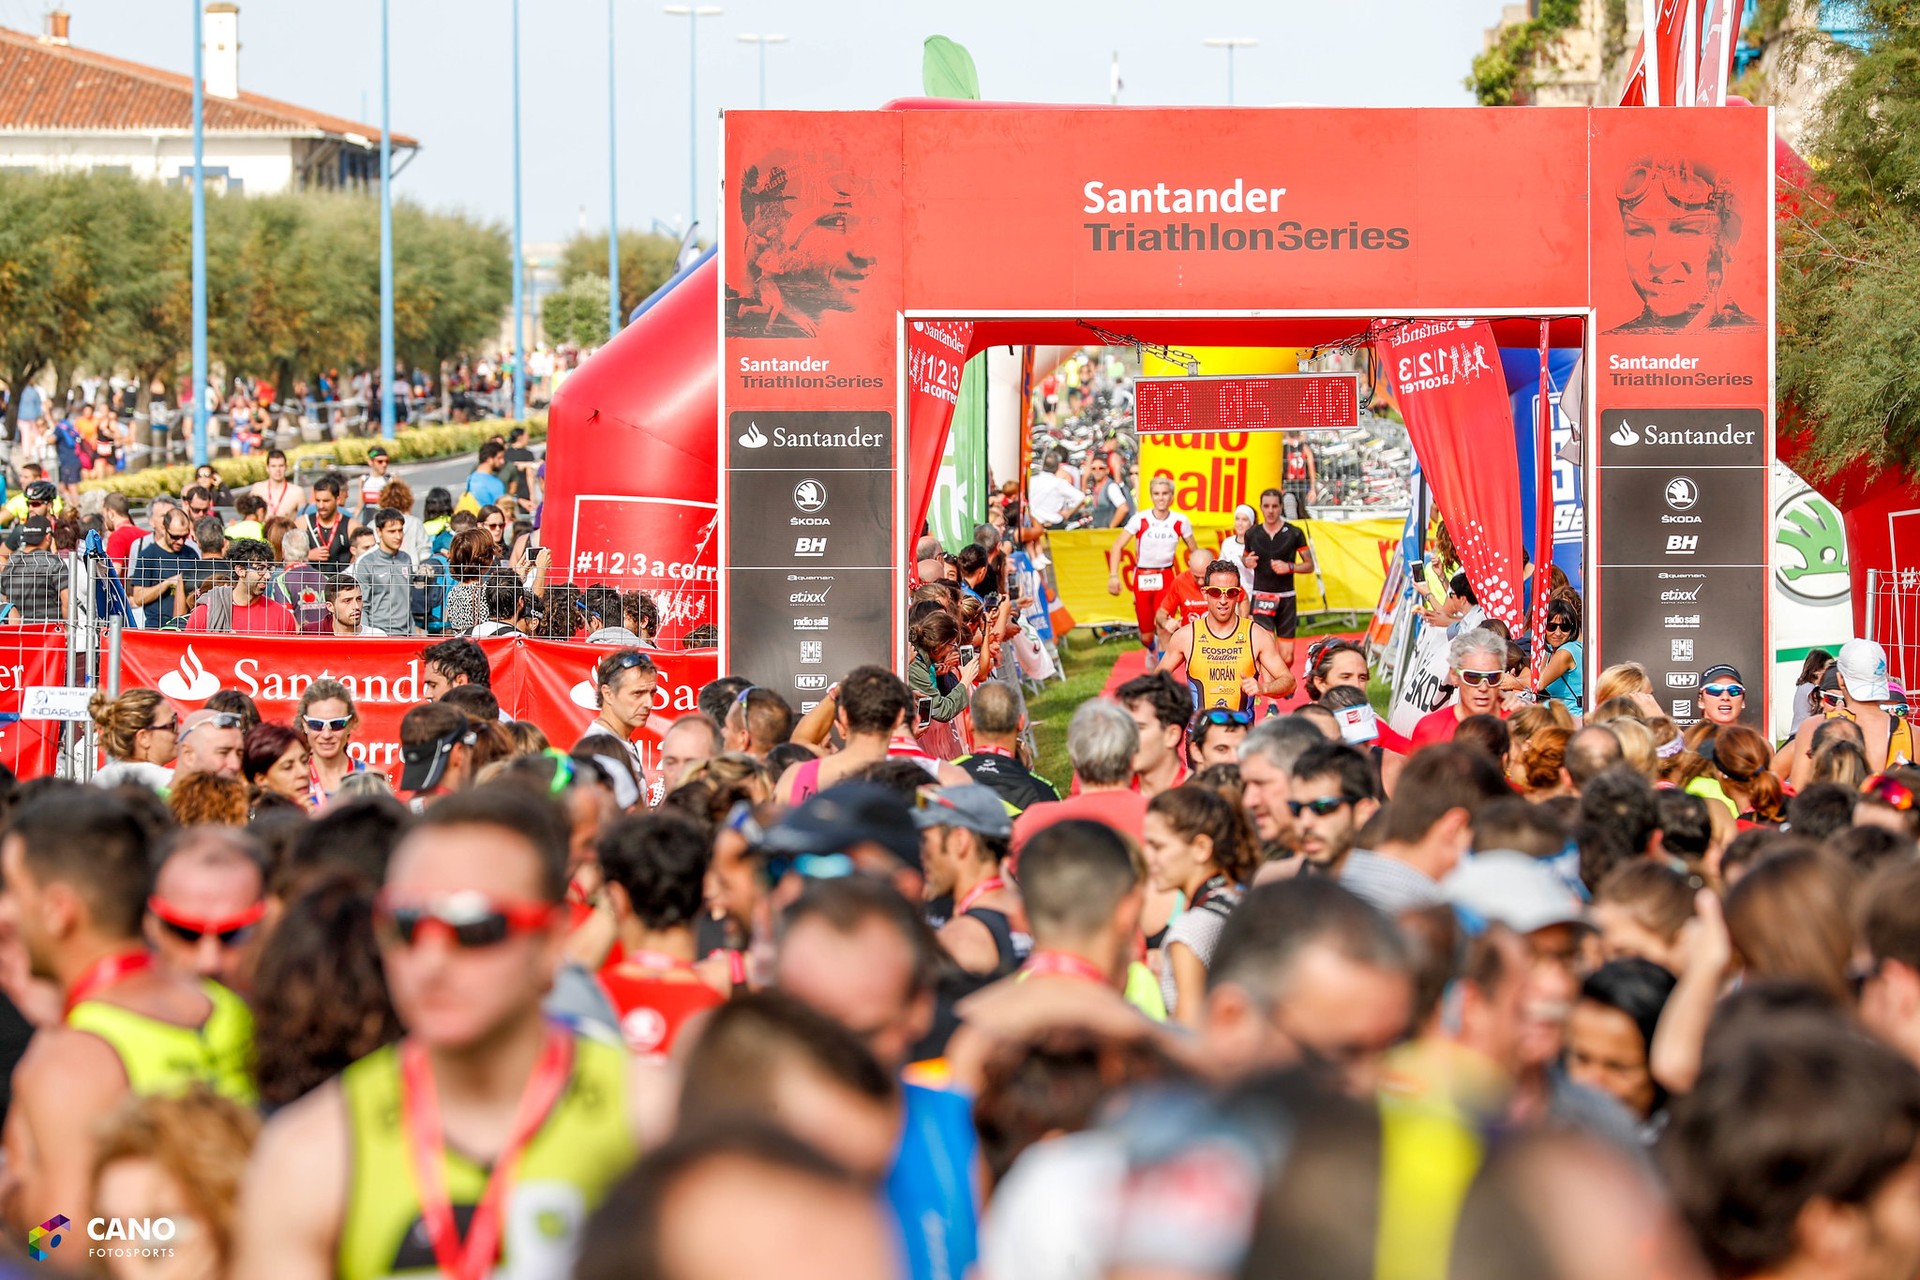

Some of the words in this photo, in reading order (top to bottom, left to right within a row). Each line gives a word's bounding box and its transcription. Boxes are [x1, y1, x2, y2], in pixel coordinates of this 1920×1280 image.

[1084, 179, 1286, 214] Santander
[923, 321, 965, 355] Santander
[740, 356, 830, 372] Santander
[1609, 354, 1699, 370] Santander
[1139, 383, 1190, 431] 03
[1219, 381, 1270, 428] 05
[1299, 379, 1350, 427] 40
[773, 426, 884, 448] Santander
[1644, 424, 1755, 445] Santander
[790, 516, 831, 526] ŠKODA
[1661, 514, 1702, 523] ŠKODA
[1147, 531, 1174, 539] CUBA
[1666, 536, 1699, 550] BH
[795, 537, 827, 553] BH
[668, 562, 718, 582] corr
[790, 587, 830, 602] etixx
[1661, 585, 1701, 601] etixx
[1201, 647, 1244, 655] ECOSPORT
[1209, 666, 1235, 681] MORÁN
